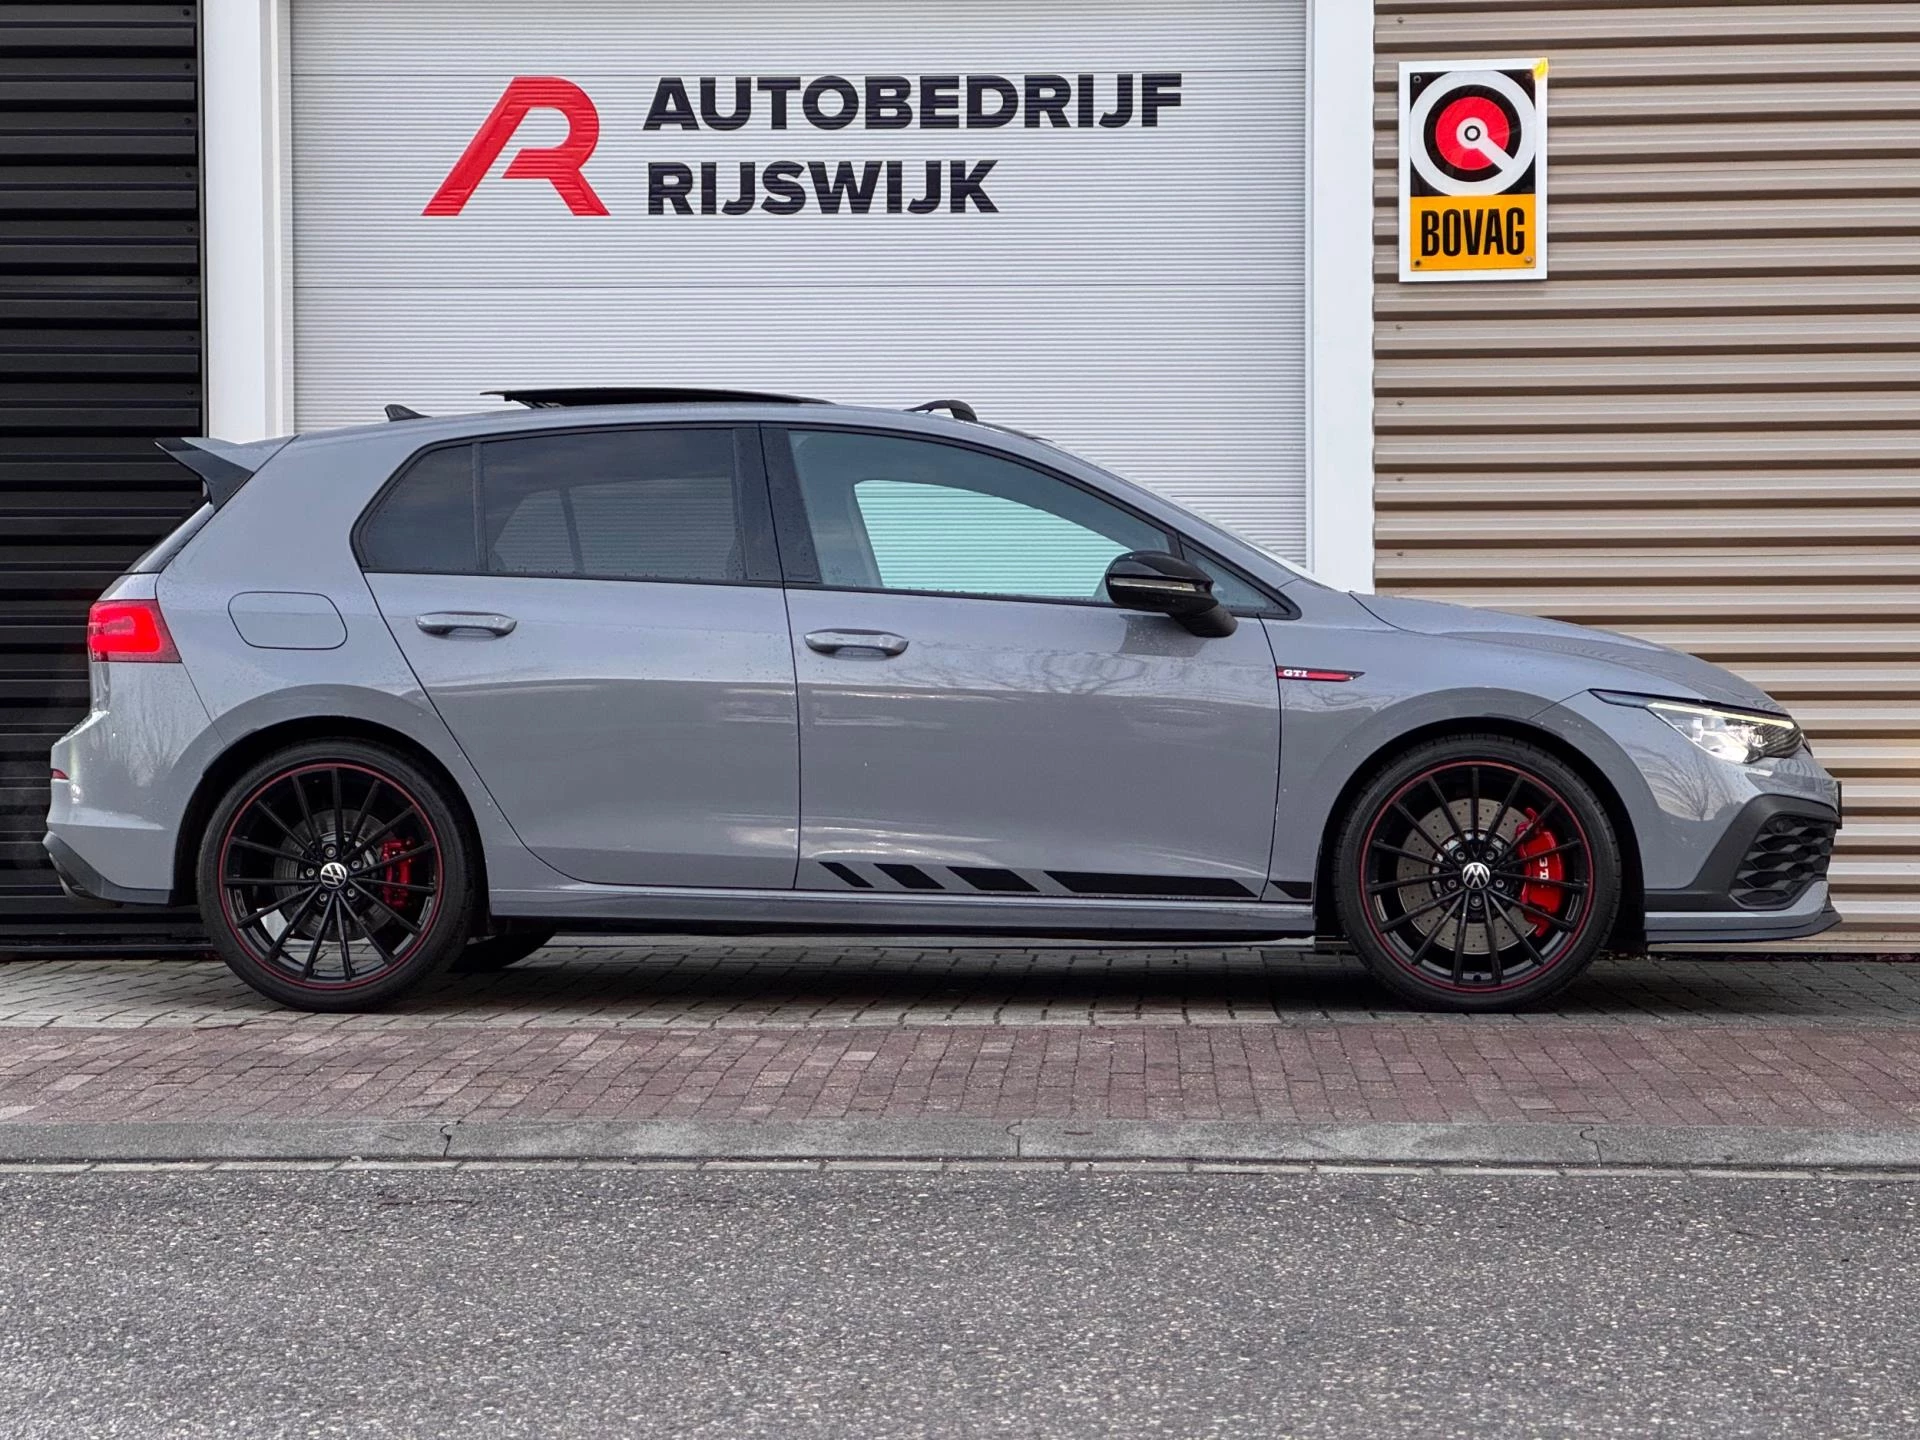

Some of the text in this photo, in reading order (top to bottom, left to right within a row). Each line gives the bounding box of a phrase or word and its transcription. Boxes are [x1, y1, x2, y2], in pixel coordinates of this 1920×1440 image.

[643, 73, 1182, 130] AUTOBEDRIJF
[647, 160, 1000, 216] RIJSWIJK
[1421, 207, 1526, 257] BOVAG
[1283, 669, 1308, 678] GTI
